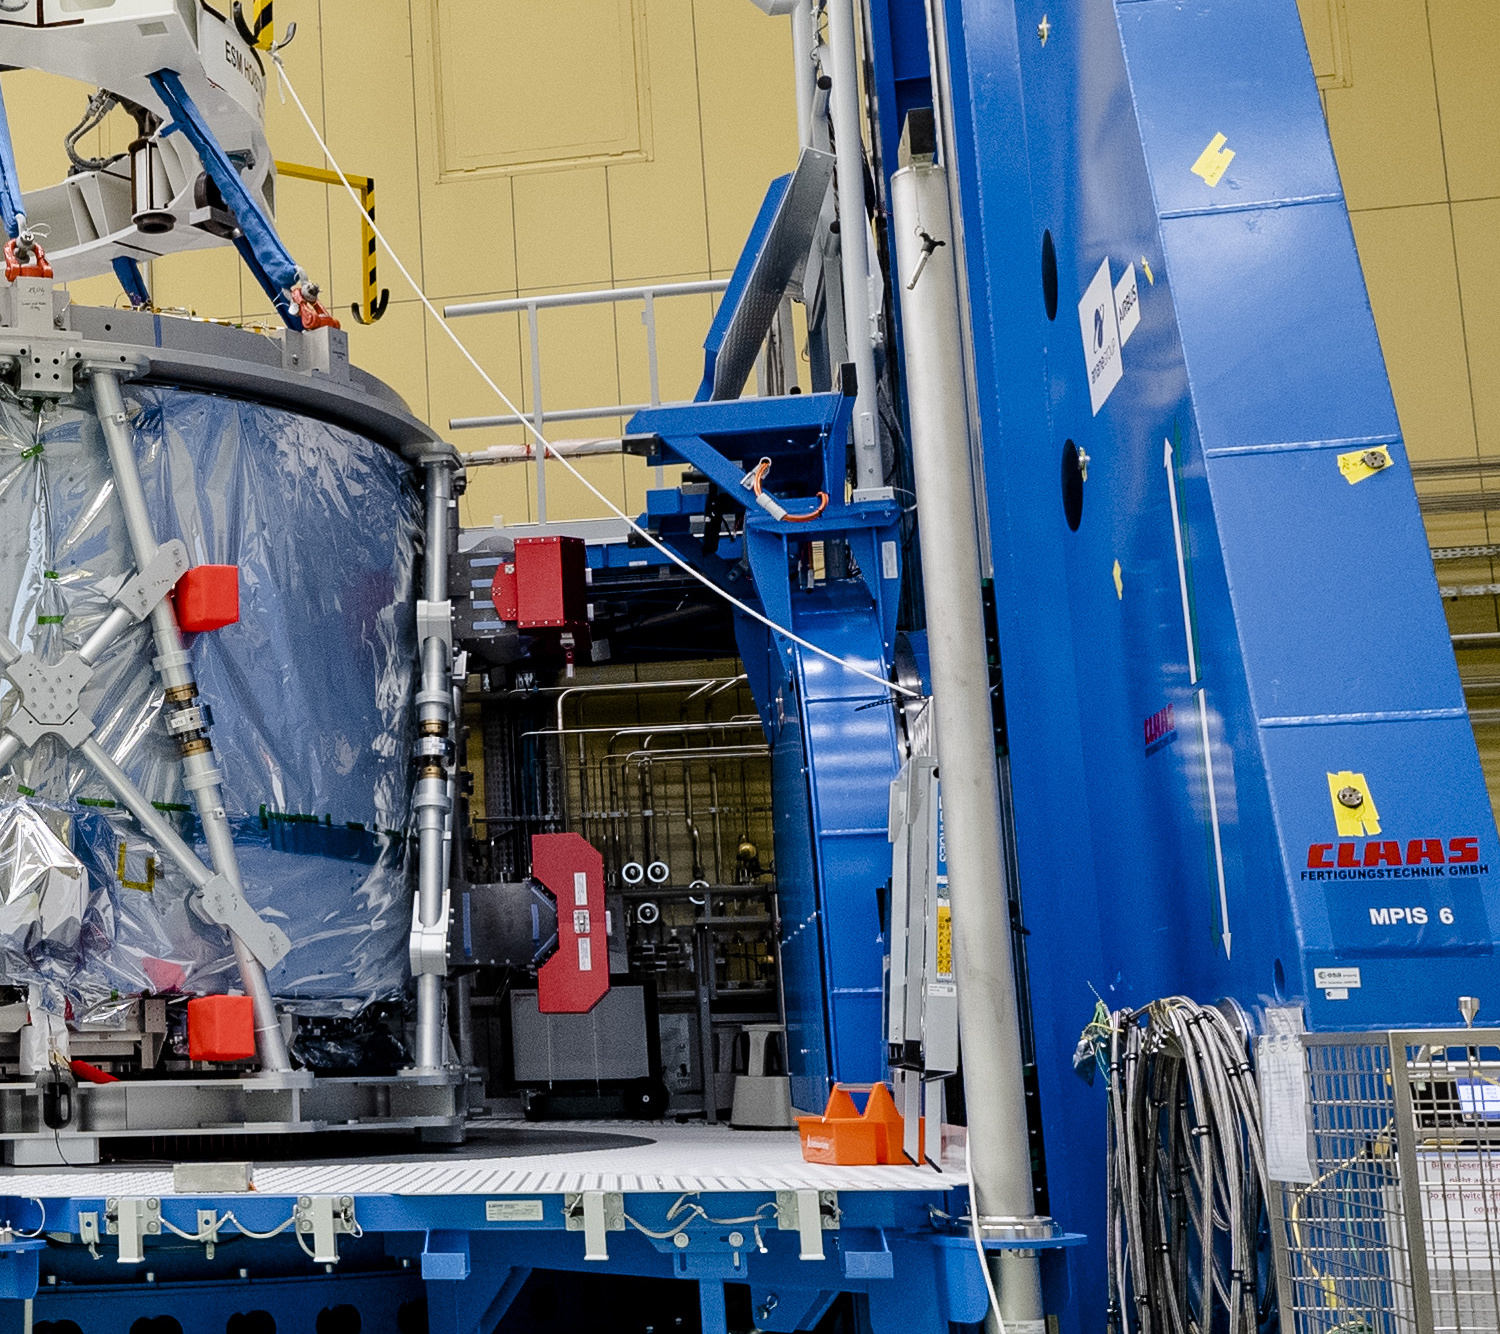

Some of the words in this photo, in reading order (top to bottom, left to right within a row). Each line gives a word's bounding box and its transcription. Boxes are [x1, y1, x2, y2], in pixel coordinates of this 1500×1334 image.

[1308, 837, 1479, 869] CLAAS
[1301, 868, 1443, 881] FERTIGUNGSTECHNIK
[1448, 864, 1489, 876] GMBH
[1369, 907, 1429, 925] MPIS
[1439, 907, 1454, 925] 6
